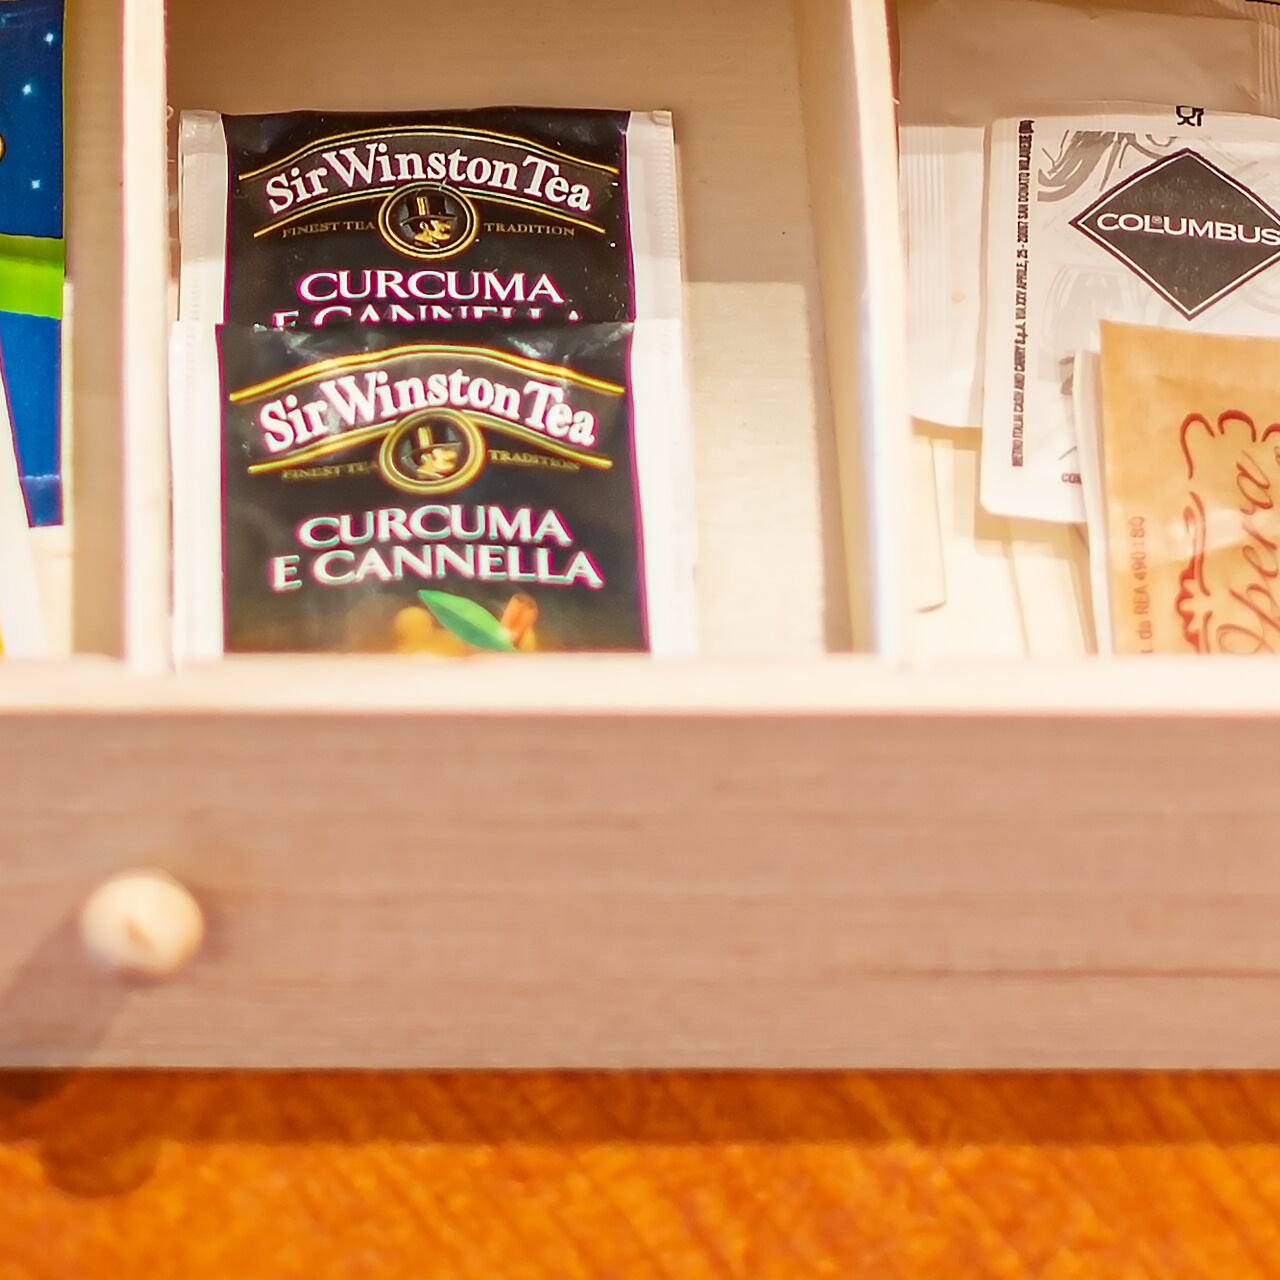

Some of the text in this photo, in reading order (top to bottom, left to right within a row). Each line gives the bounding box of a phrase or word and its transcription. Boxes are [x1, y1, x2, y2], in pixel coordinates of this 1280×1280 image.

[281, 221, 341, 238] FINEST
[483, 222, 575, 237] TRADITION
[297, 270, 564, 303] CURCUMA
[296, 504, 572, 549] CURCUMA
[271, 543, 604, 591] E CANNELLA
